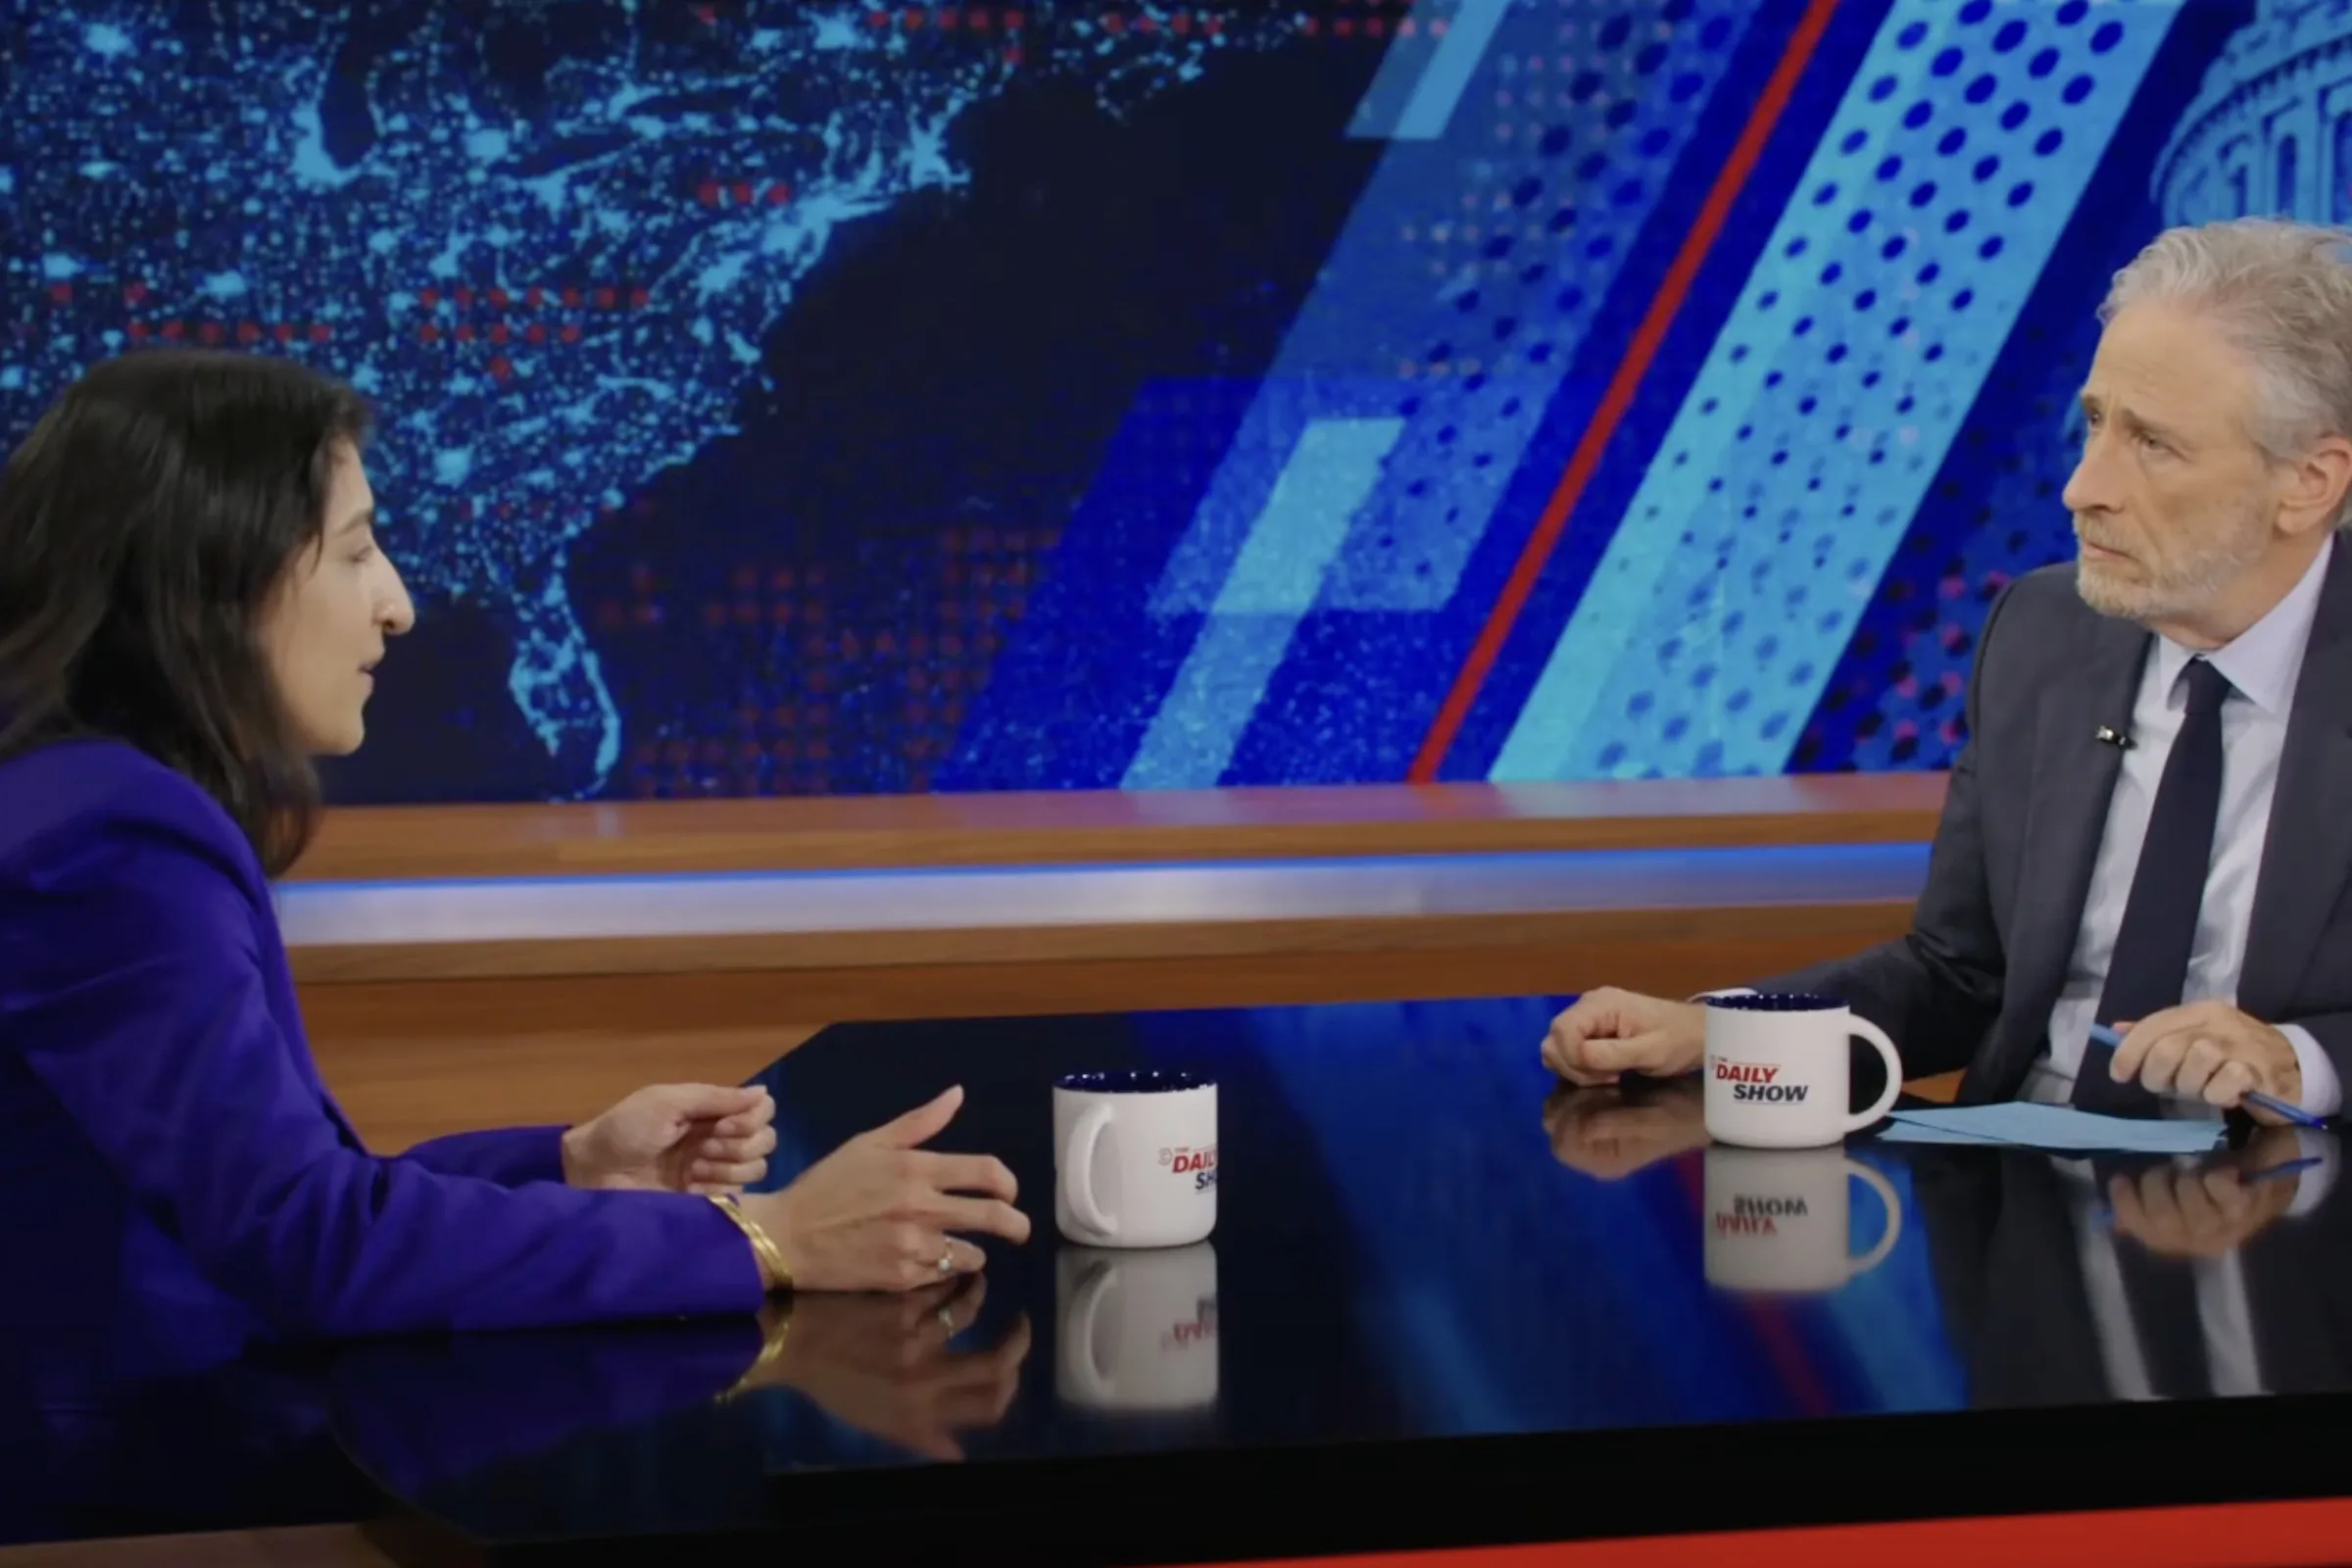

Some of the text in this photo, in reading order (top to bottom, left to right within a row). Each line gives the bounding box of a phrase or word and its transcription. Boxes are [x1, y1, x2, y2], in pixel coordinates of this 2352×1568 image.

[1716, 1063, 1779, 1084] DAILY
[1733, 1083, 1809, 1102] SHOW
[1172, 1152, 1217, 1173] DAIL
[1195, 1171, 1217, 1190] SH
